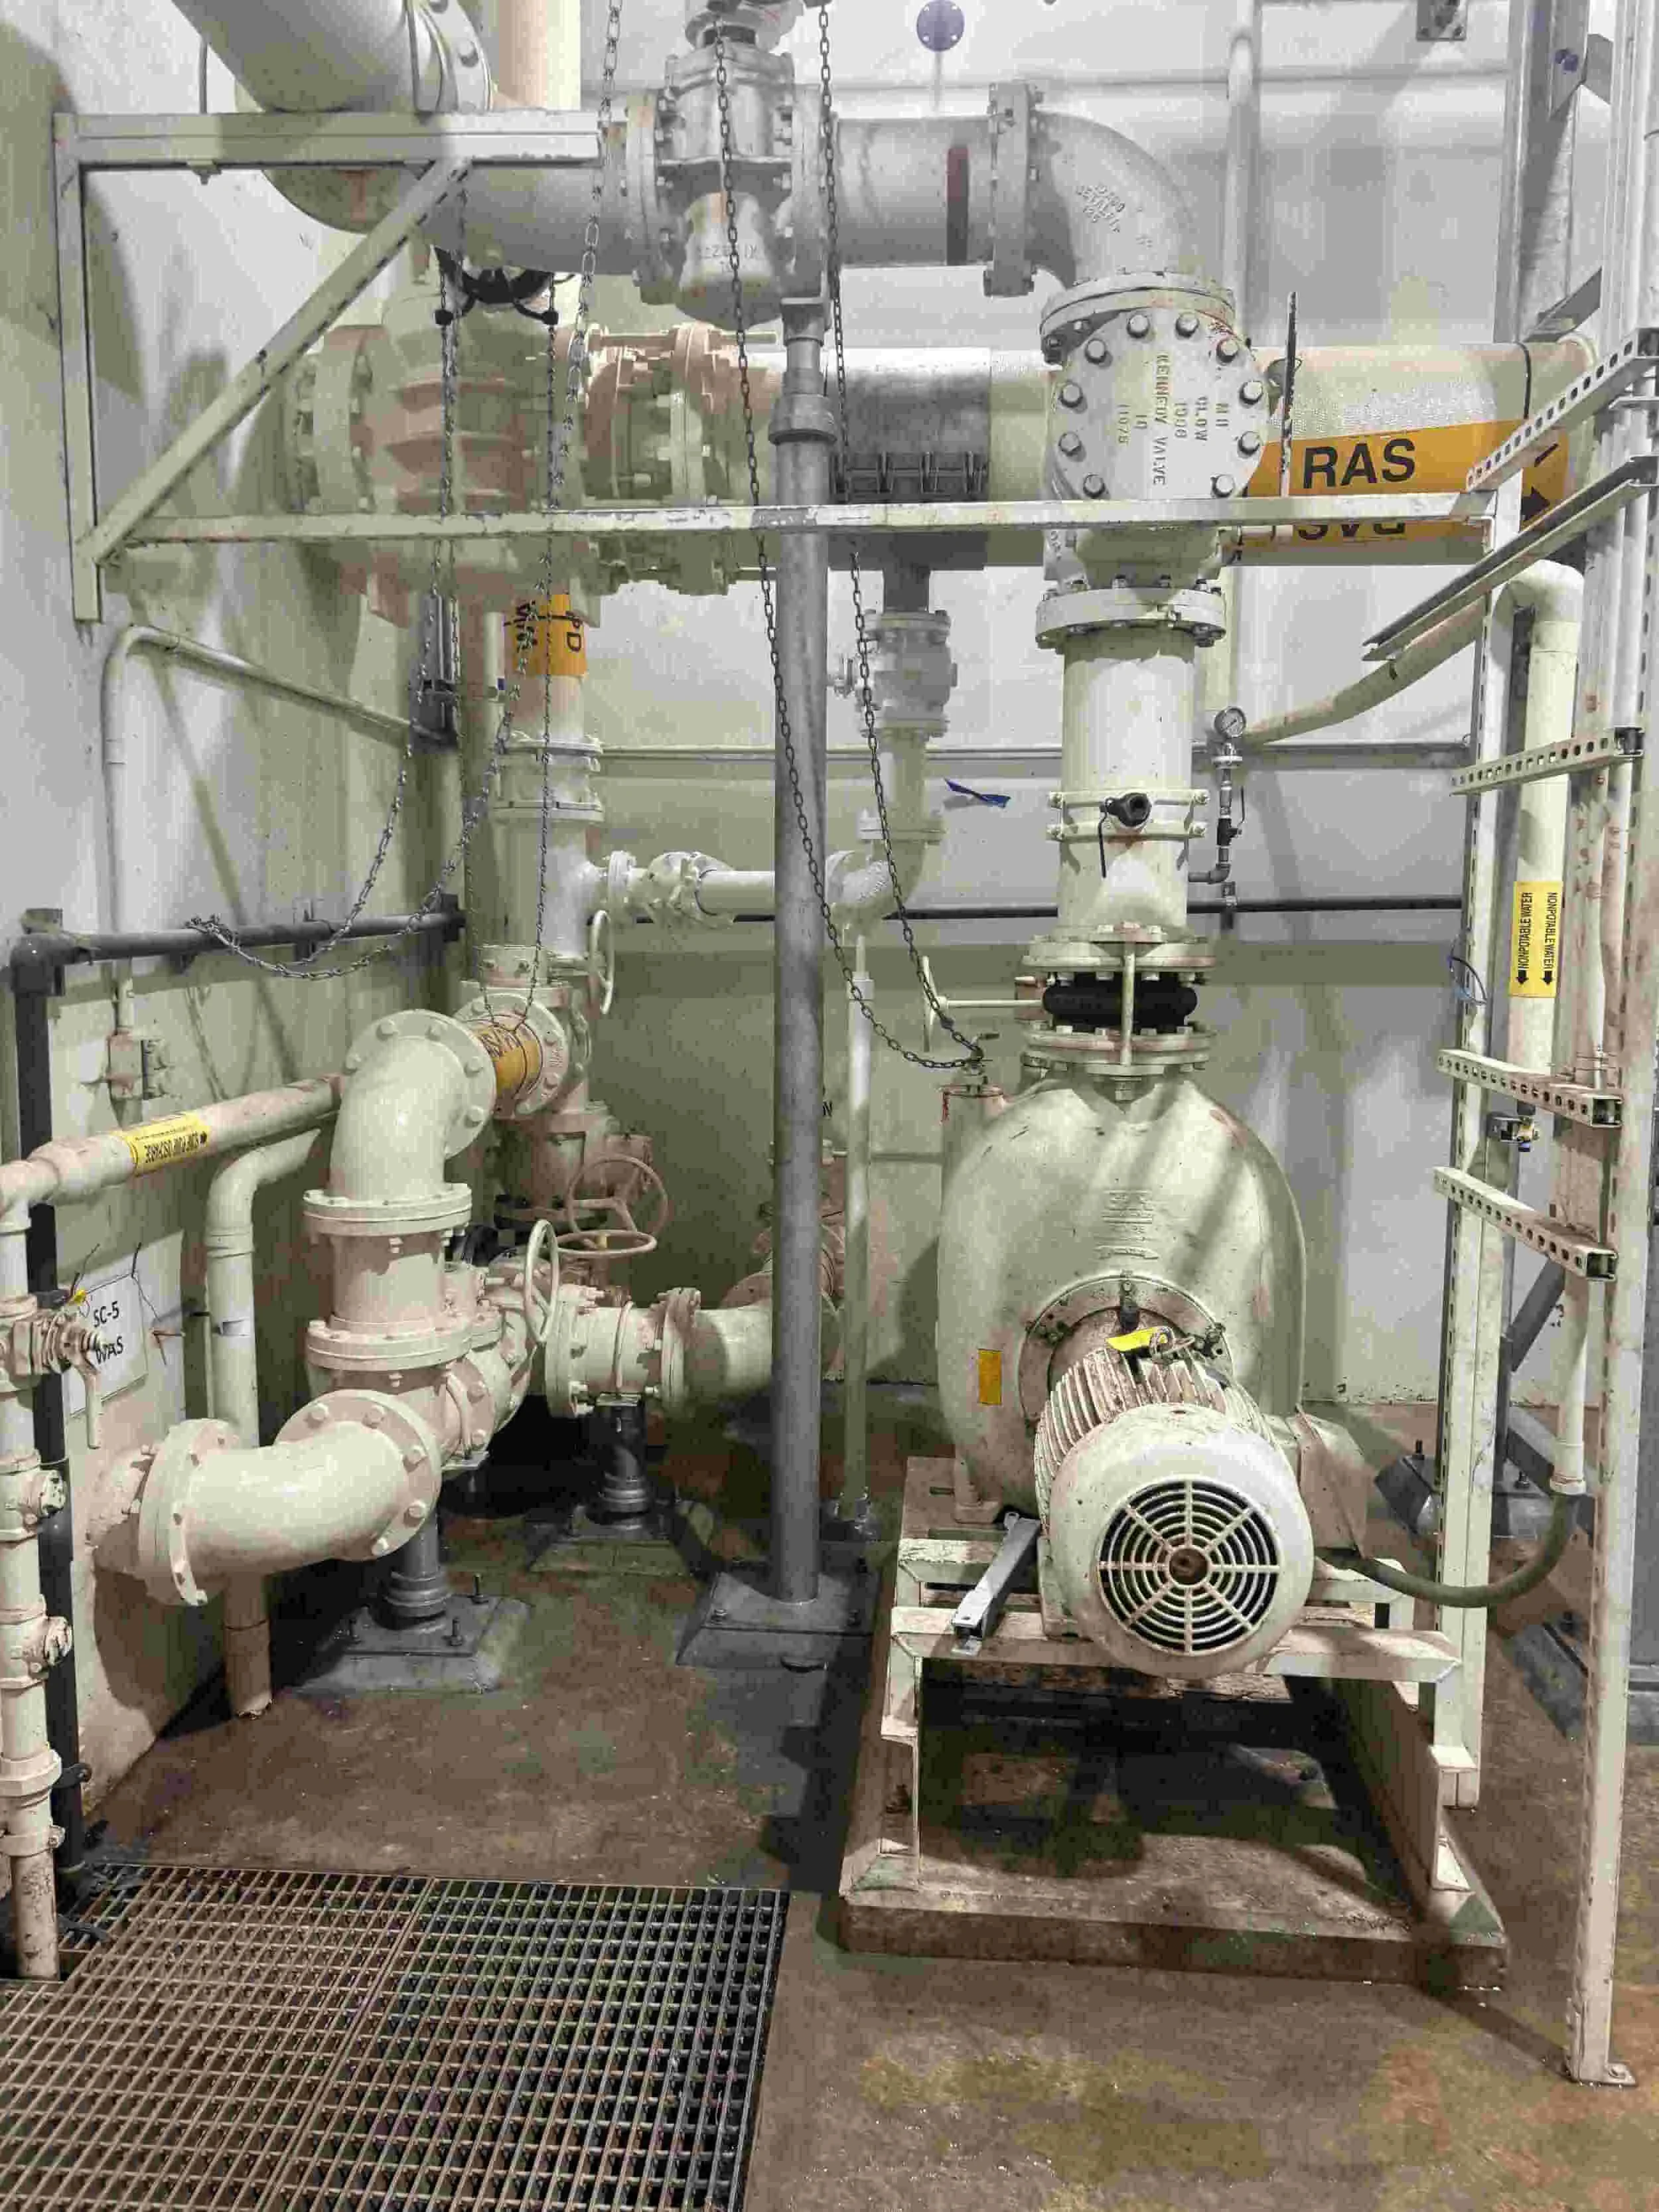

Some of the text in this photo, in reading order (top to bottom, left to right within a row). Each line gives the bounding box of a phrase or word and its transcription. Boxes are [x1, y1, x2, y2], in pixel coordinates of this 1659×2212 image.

[1153, 354, 1169, 485] KENNEDY VALVE
[1303, 439, 1415, 489] RAS
[1518, 892, 1532, 969] NONPOTABLE WATER
[1544, 892, 1557, 969] NONPOTABLE WATER
[94, 1301, 119, 1327] SC-5
[96, 1336, 123, 1364] WAS
